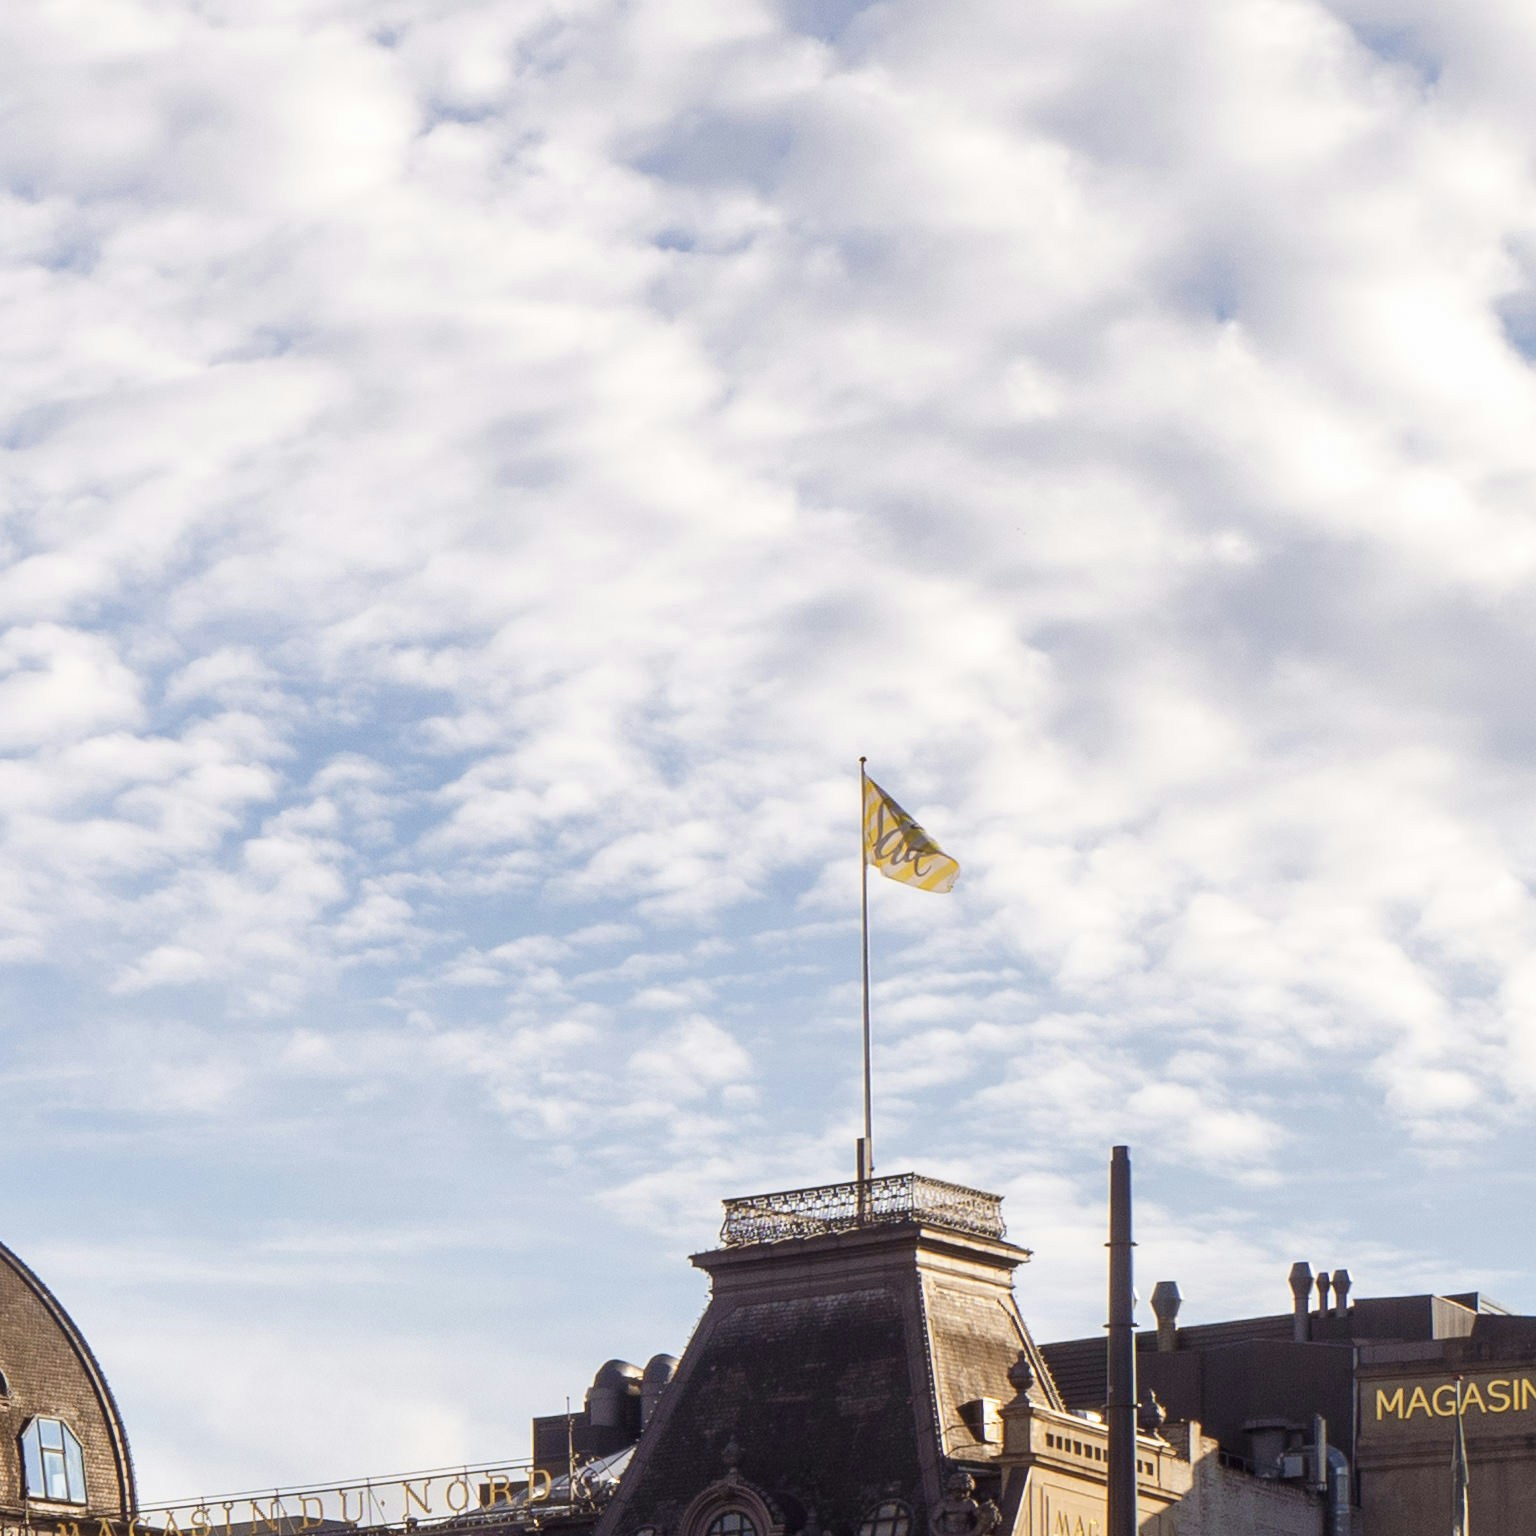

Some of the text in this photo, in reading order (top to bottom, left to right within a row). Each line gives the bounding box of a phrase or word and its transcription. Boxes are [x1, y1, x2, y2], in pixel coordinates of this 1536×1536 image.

[1375, 1377, 1536, 1422] MAGASIN
[298, 1487, 364, 1535] DU
[401, 1467, 553, 1522] NORD
